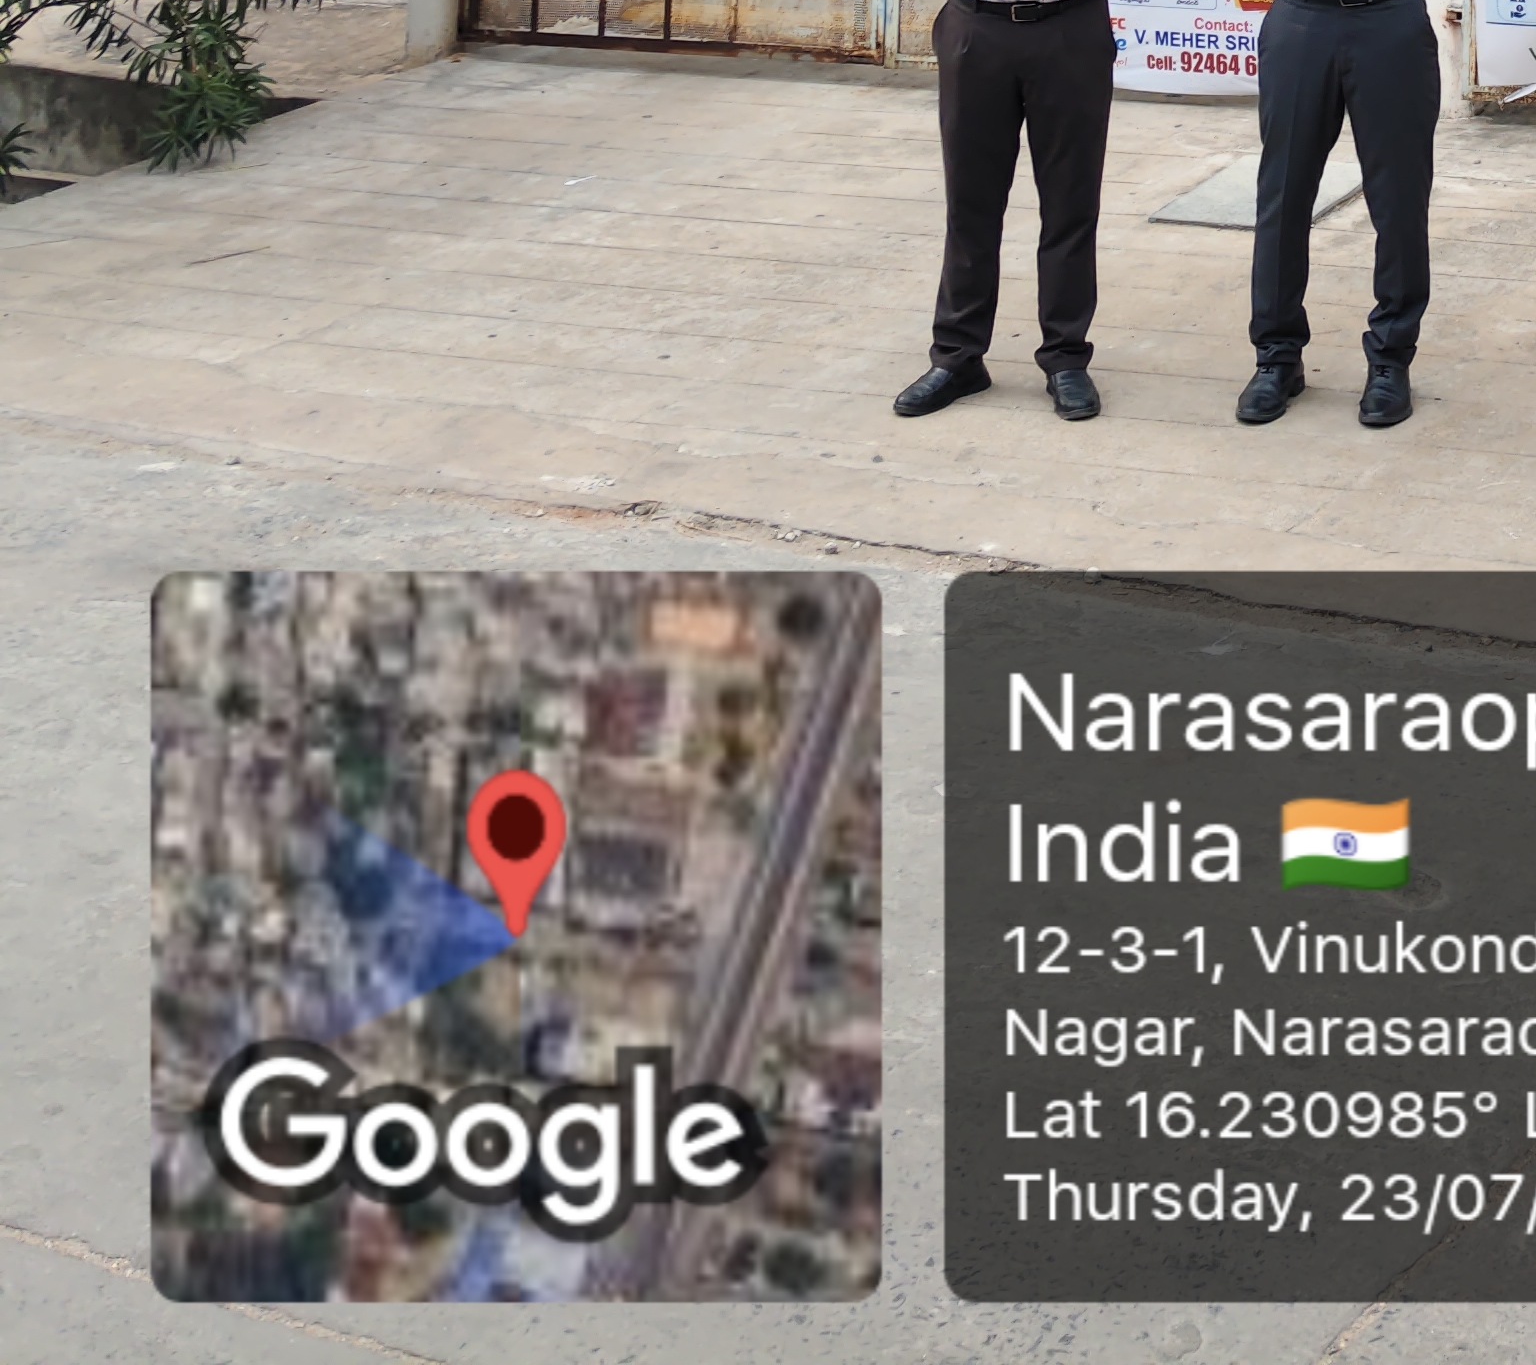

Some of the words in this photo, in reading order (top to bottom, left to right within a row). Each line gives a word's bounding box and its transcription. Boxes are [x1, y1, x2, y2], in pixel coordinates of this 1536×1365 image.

[1194, 17, 1254, 34] Contact:
[1134, 29, 1149, 45] V.
[1155, 30, 1220, 50] MEHER
[1225, 35, 1256, 52] SRI
[1147, 54, 1177, 72] Cell:
[1180, 51, 1241, 76] 92464
